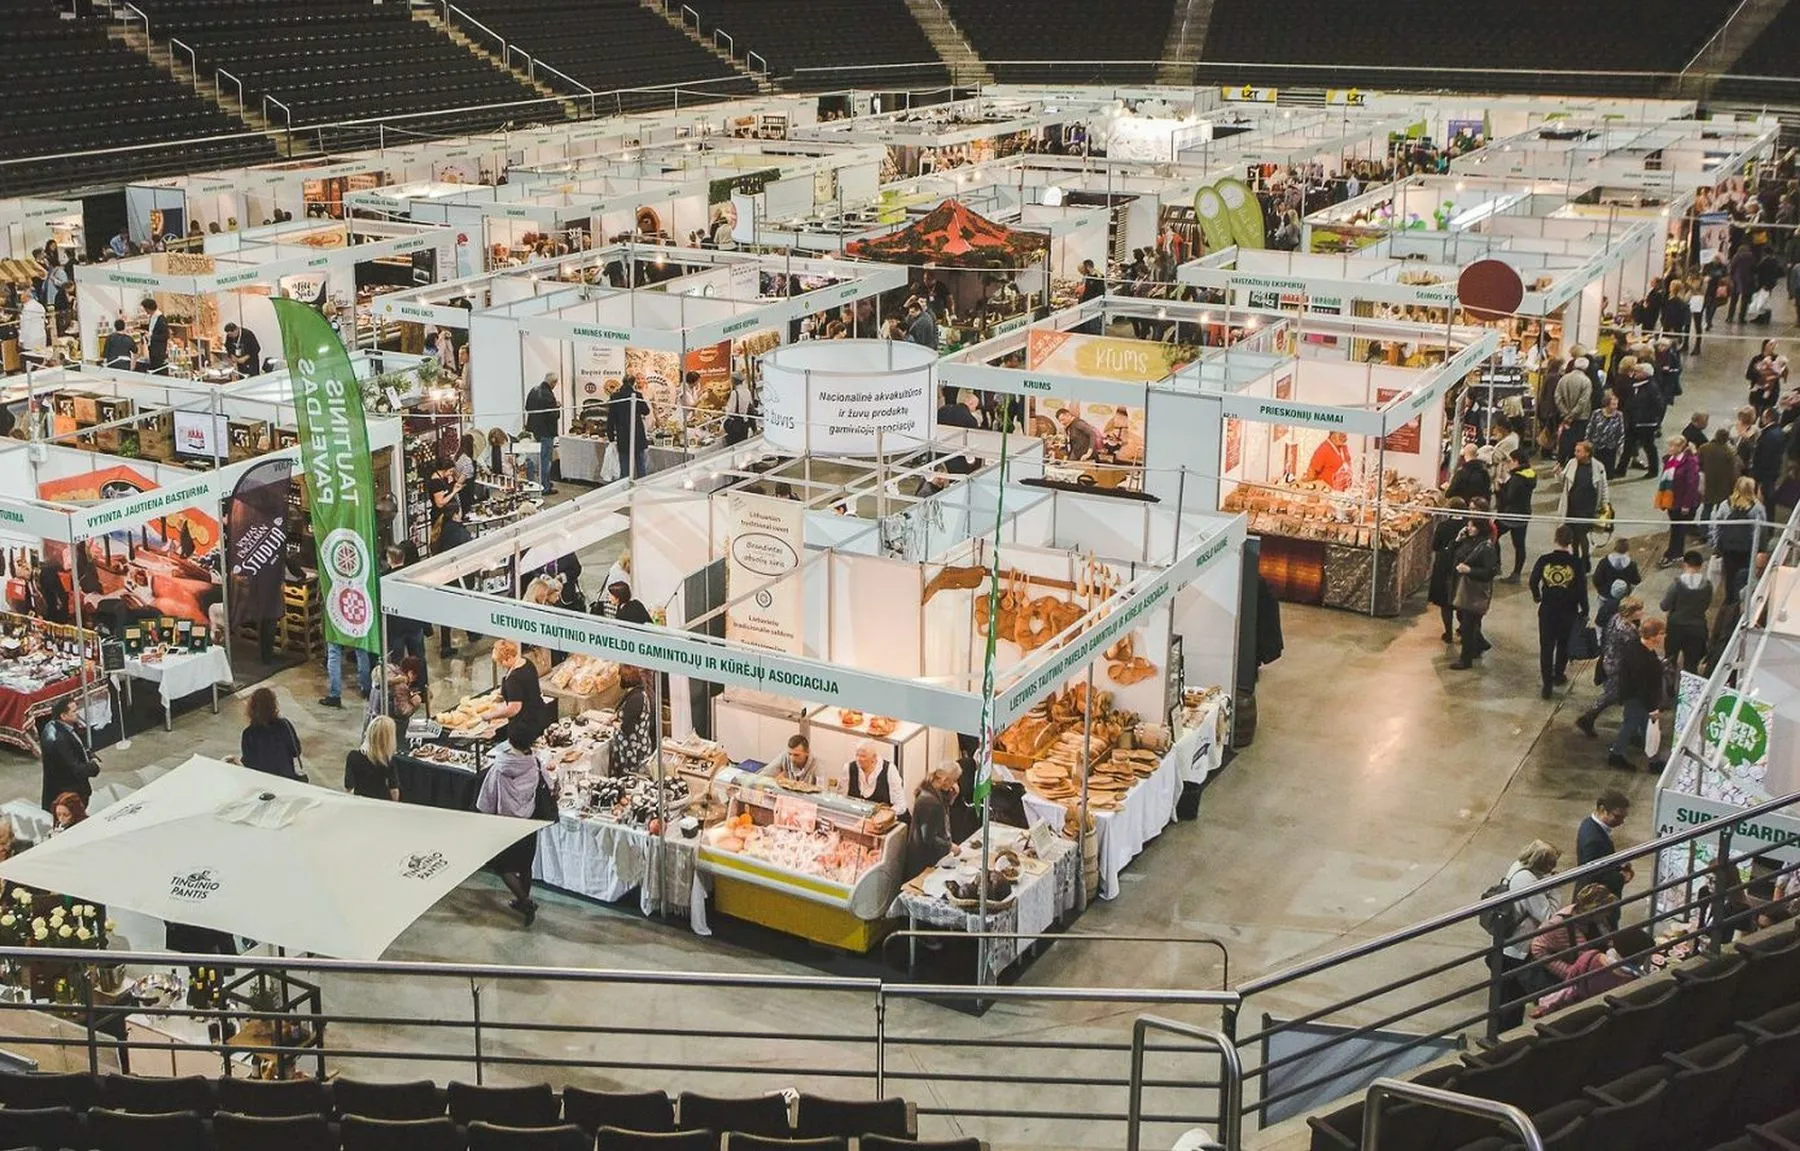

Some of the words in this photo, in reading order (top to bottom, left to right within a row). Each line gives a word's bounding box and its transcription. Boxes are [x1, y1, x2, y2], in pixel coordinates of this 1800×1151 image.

[1023, 380, 1052, 391] KRUMS
[838, 408, 845, 418] ir
[1260, 405, 1312, 422] PRIESKONIŲ
[1314, 412, 1344, 424] NAMAI
[87, 509, 122, 528] VYTINTA
[124, 497, 164, 516] JAUTIENA
[165, 484, 210, 505] BASTURMA
[490, 613, 537, 633] LIETUVOS
[540, 622, 586, 643] TAUTINIO
[588, 633, 635, 653] PAVELDO
[638, 644, 702, 669] GAMINTOJŲ
[705, 657, 717, 670] IR
[720, 658, 765, 681] KŪRĖJŲ
[769, 670, 839, 694] ASOCIACIJA
[170, 875, 220, 892] TINGINIO
[171, 886, 210, 899] PANTIS
